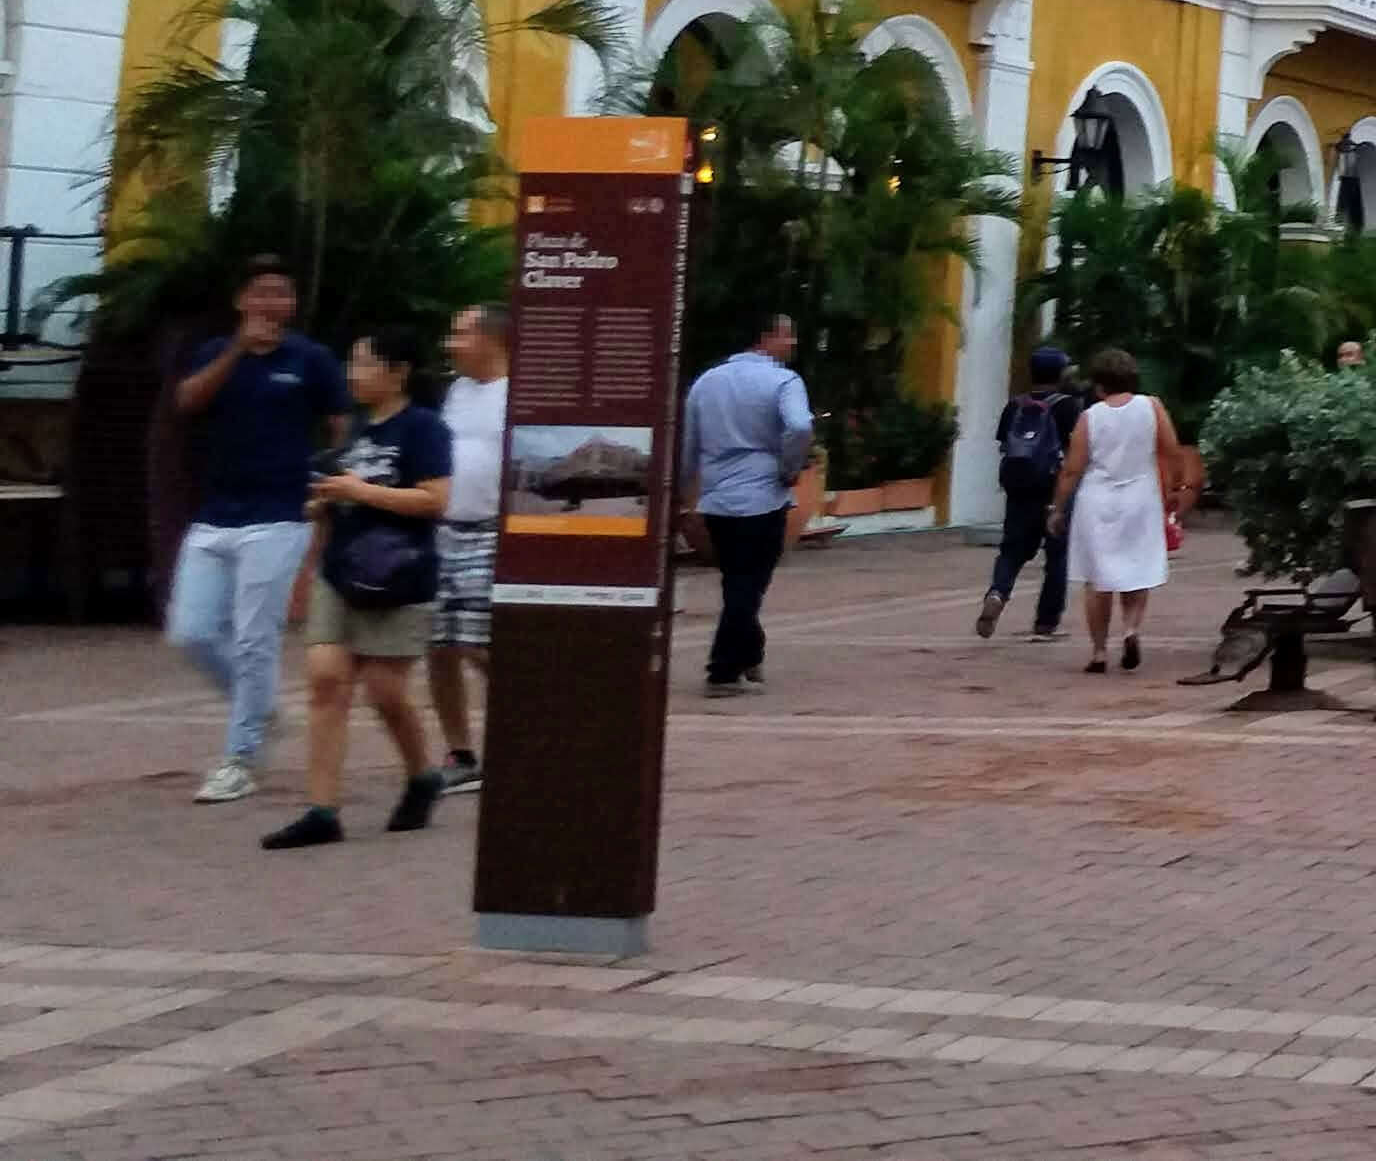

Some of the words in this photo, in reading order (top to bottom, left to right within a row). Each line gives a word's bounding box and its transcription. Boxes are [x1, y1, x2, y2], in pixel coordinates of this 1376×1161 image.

[524, 251, 561, 269] San
[562, 250, 619, 270] Pedro
[522, 270, 585, 289] Claver
